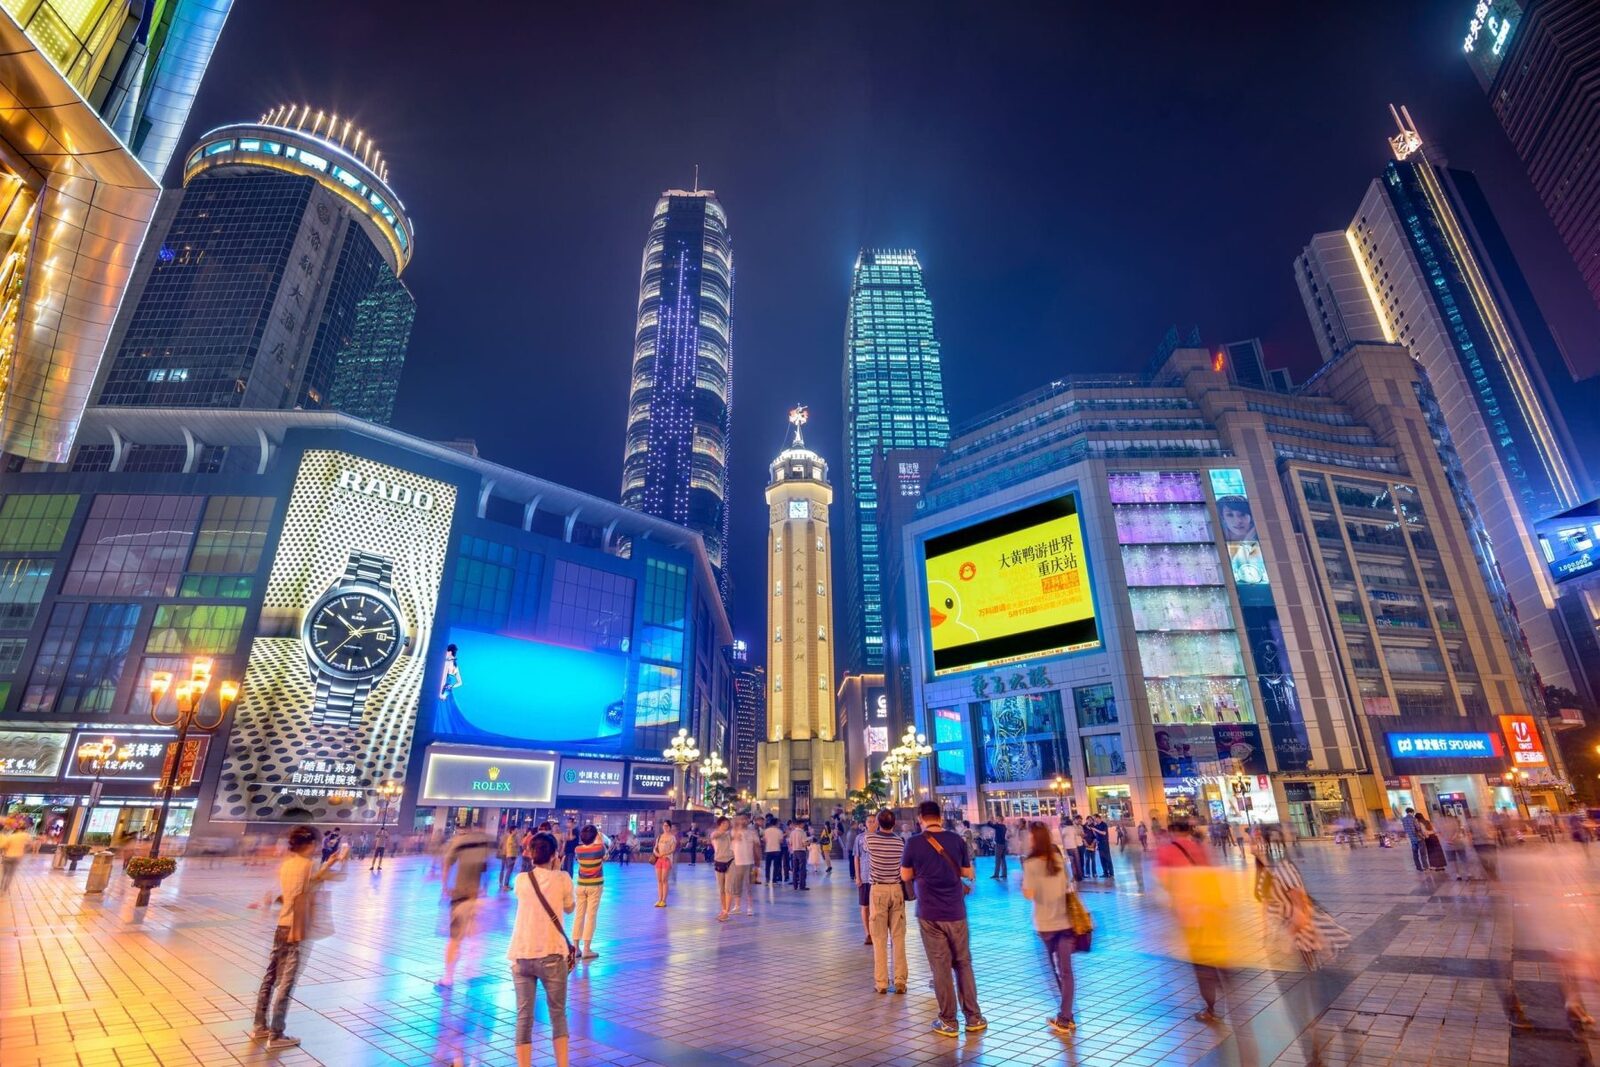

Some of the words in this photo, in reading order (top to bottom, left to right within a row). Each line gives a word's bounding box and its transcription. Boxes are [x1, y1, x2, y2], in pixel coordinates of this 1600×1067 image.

[338, 469, 434, 511] RADO
[999, 534, 1074, 569] 大黄鸭游世界
[1038, 552, 1078, 577] 重庆站
[1464, 740, 1486, 750] BANK
[291, 772, 358, 786] 自动机械腕表
[635, 774, 671, 782] STARBUCKS
[472, 781, 512, 792] ROLEX
